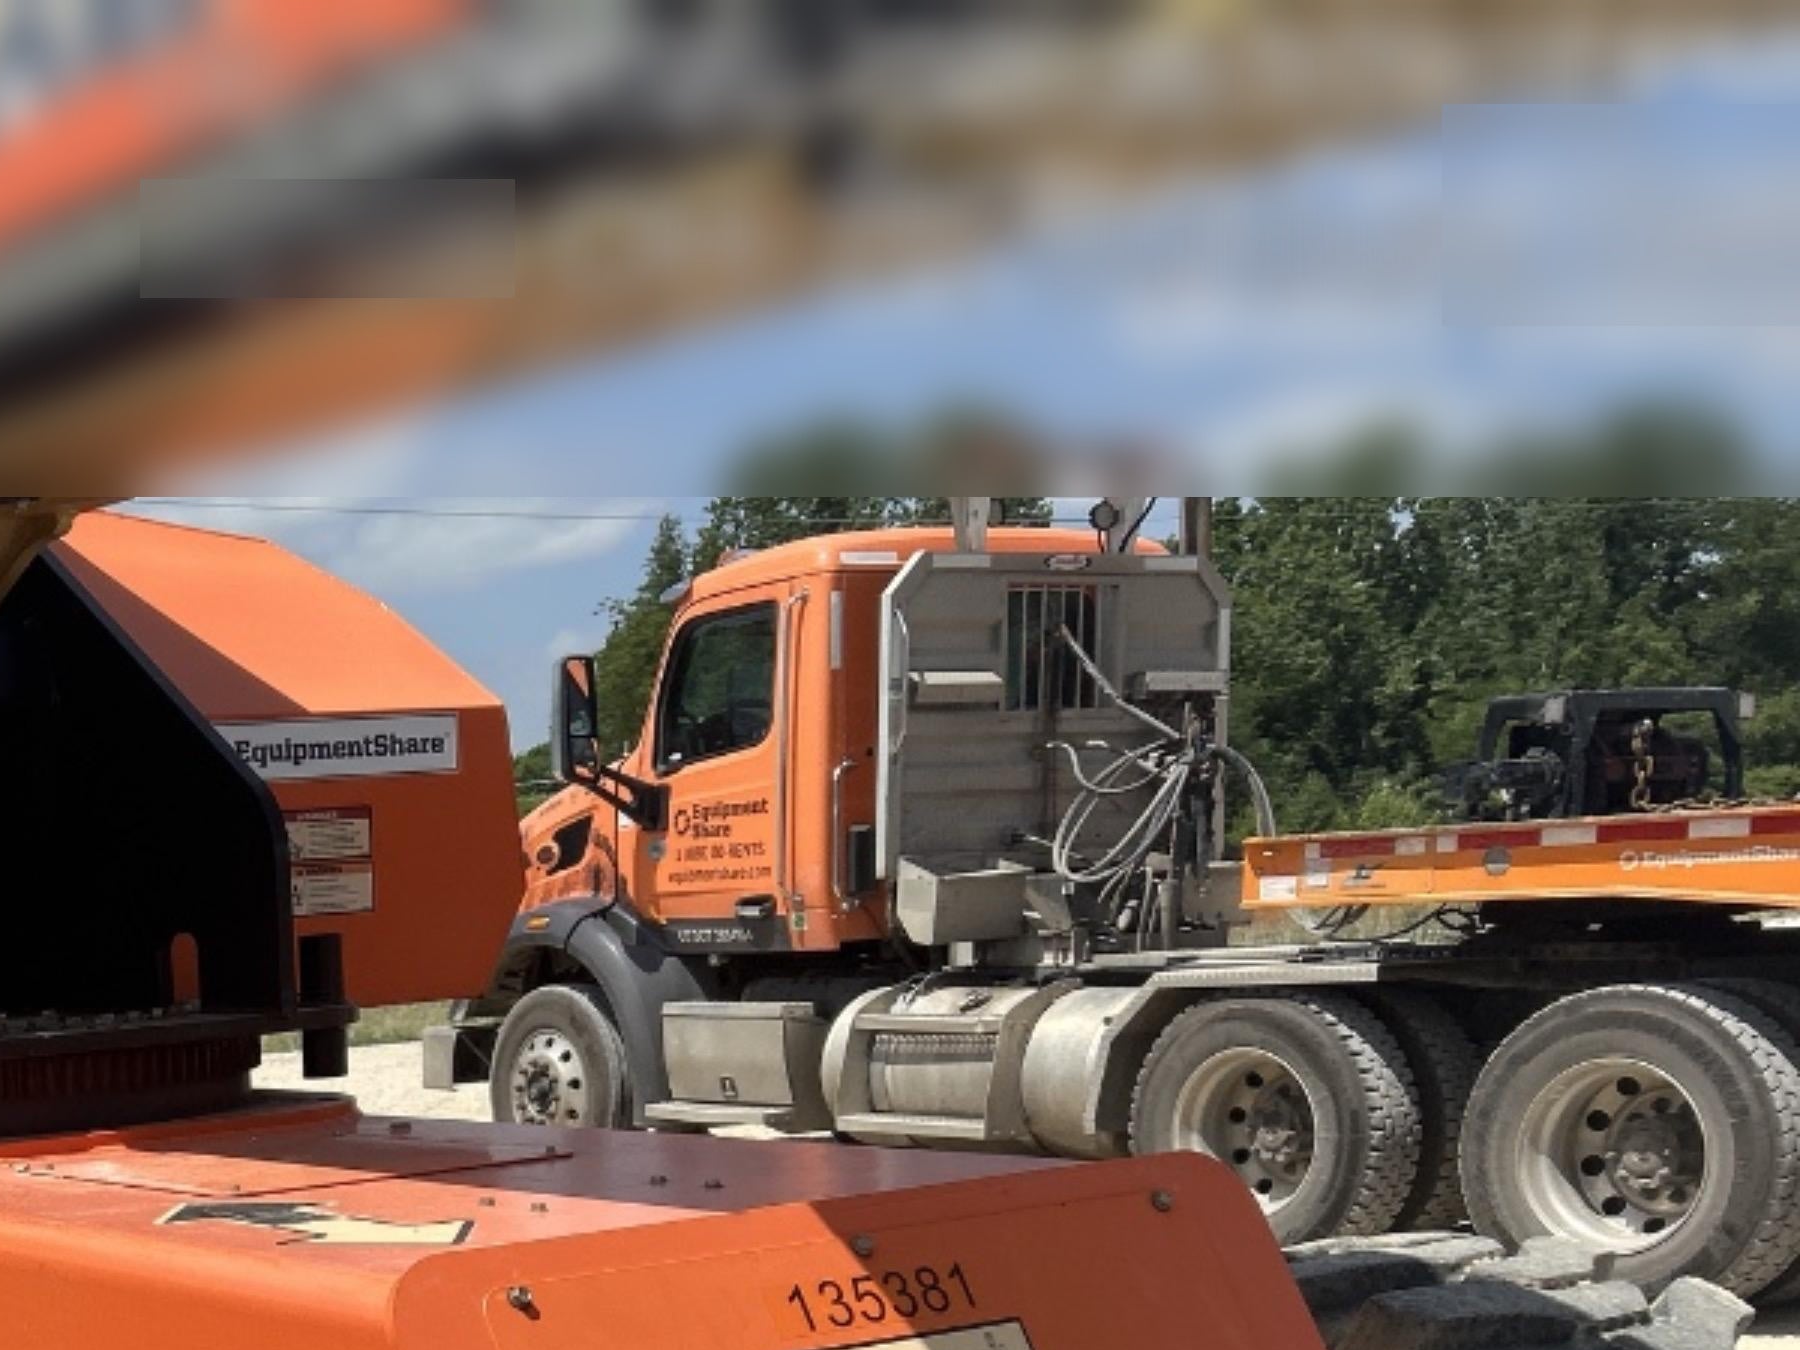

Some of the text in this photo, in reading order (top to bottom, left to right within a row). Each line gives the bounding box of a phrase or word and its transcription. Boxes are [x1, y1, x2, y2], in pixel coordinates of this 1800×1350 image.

[235, 734, 444, 769] EquipmentShare
[691, 797, 769, 823] Equipment
[692, 823, 731, 839] Share
[788, 1262, 976, 1332] 135381
